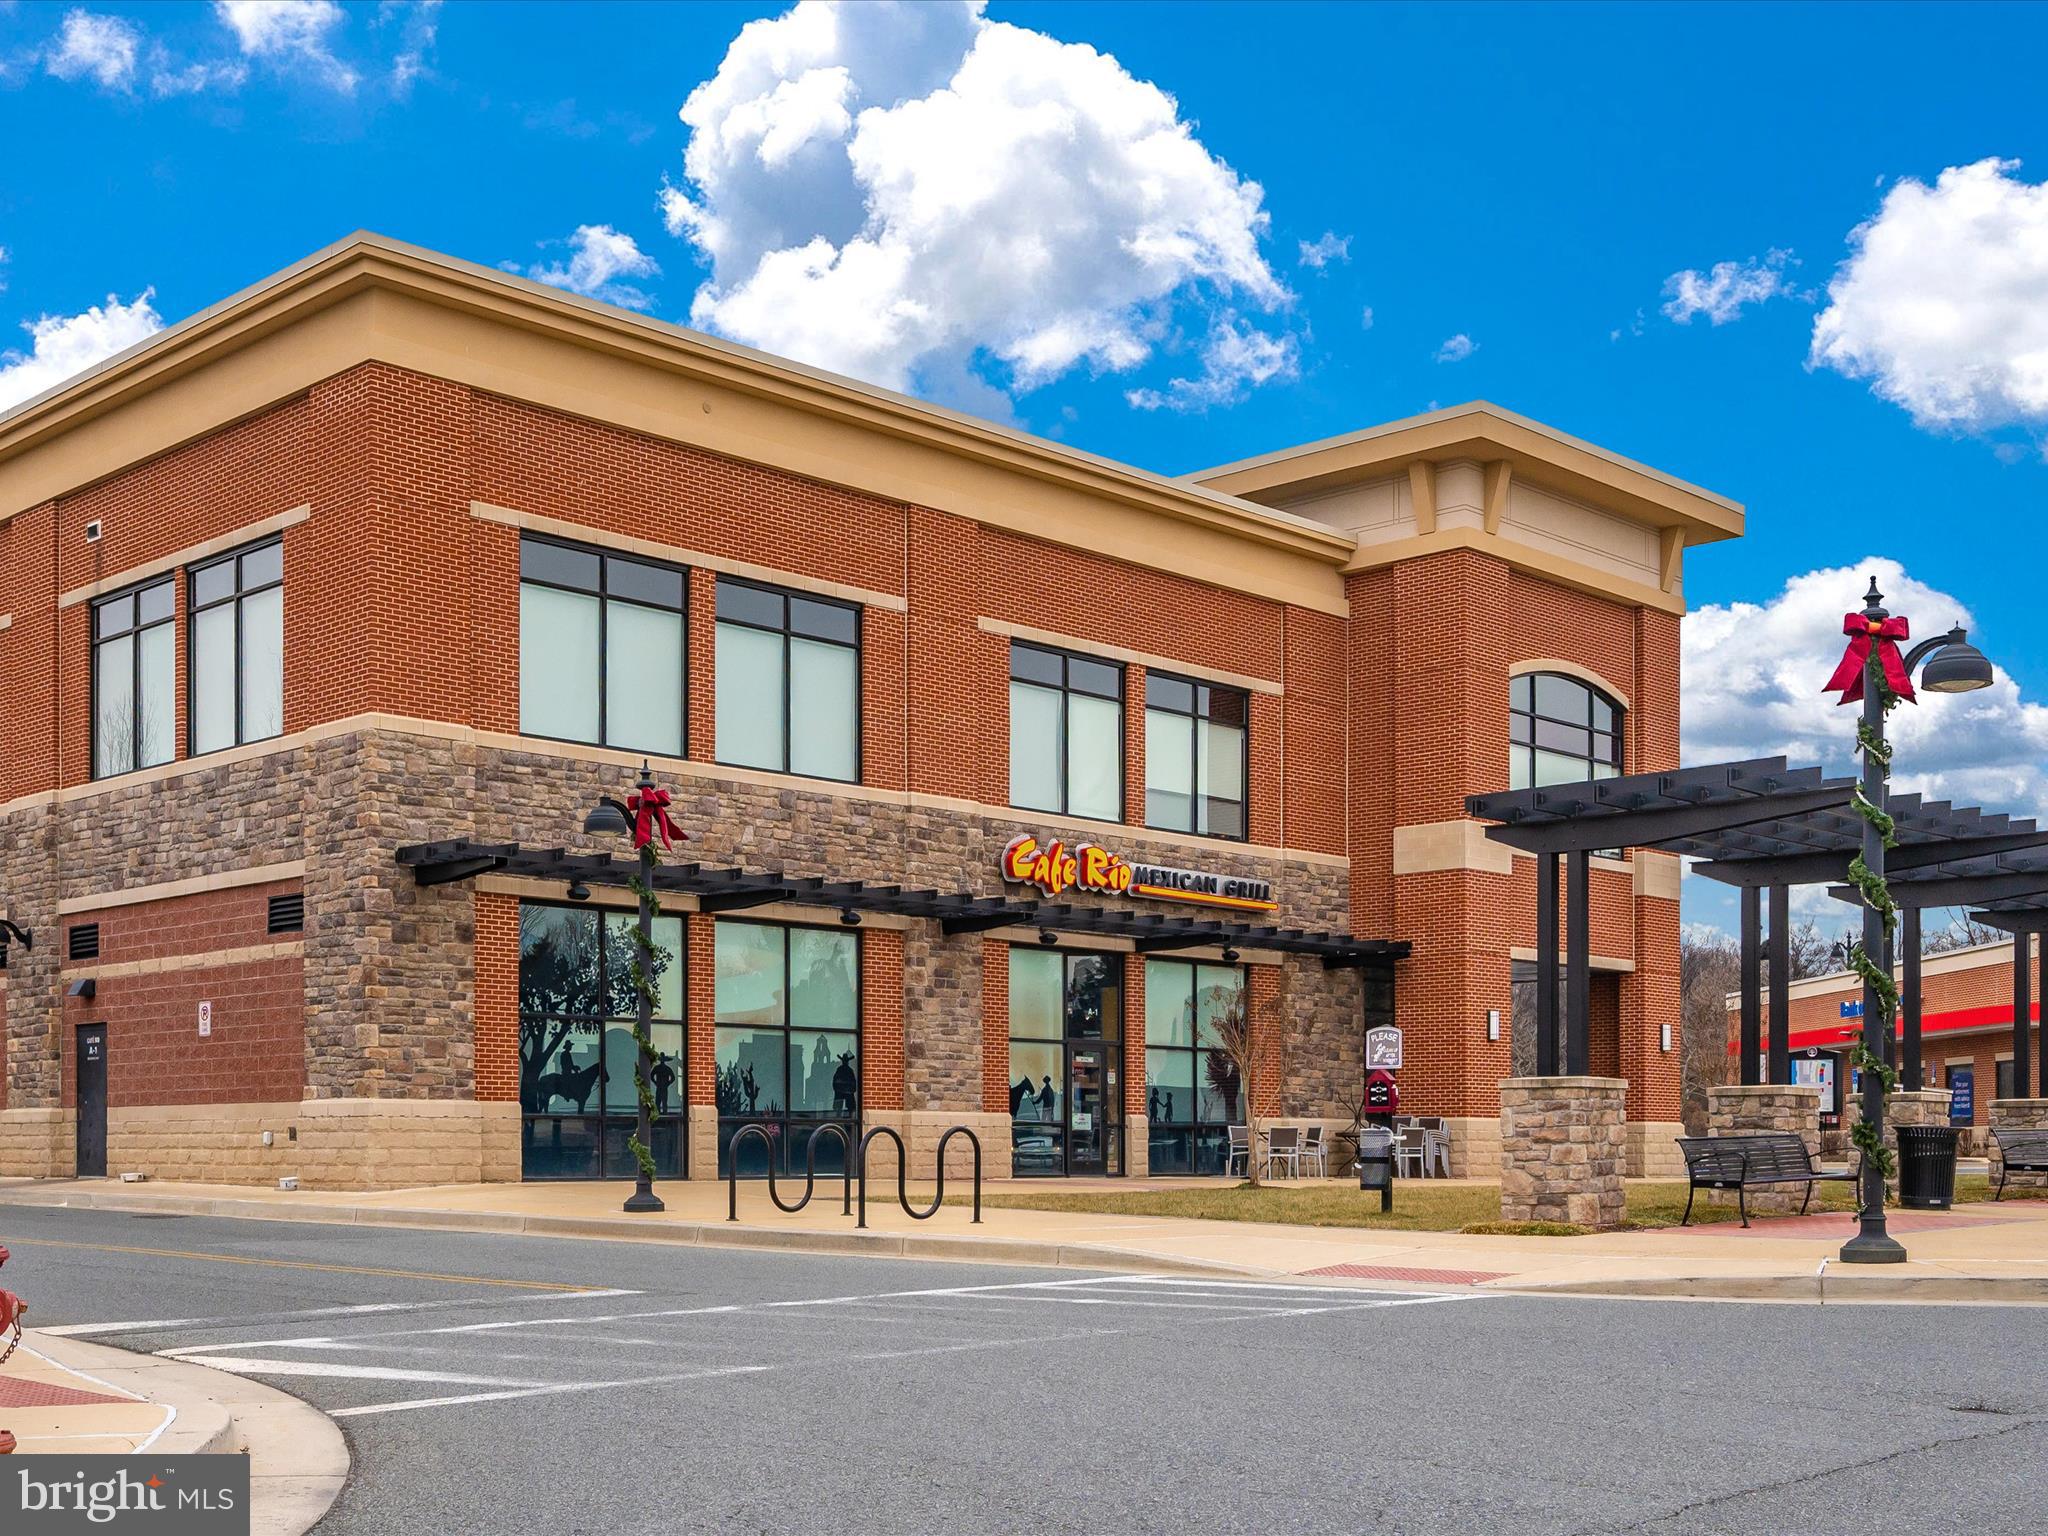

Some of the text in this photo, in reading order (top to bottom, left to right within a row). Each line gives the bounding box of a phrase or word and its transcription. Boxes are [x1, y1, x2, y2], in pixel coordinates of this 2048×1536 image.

[1084, 844, 1132, 891] Rio
[1132, 866, 1218, 894] MEXICAN
[1224, 880, 1272, 900] GRILL
[1370, 1032, 1398, 1042] PLEASE
